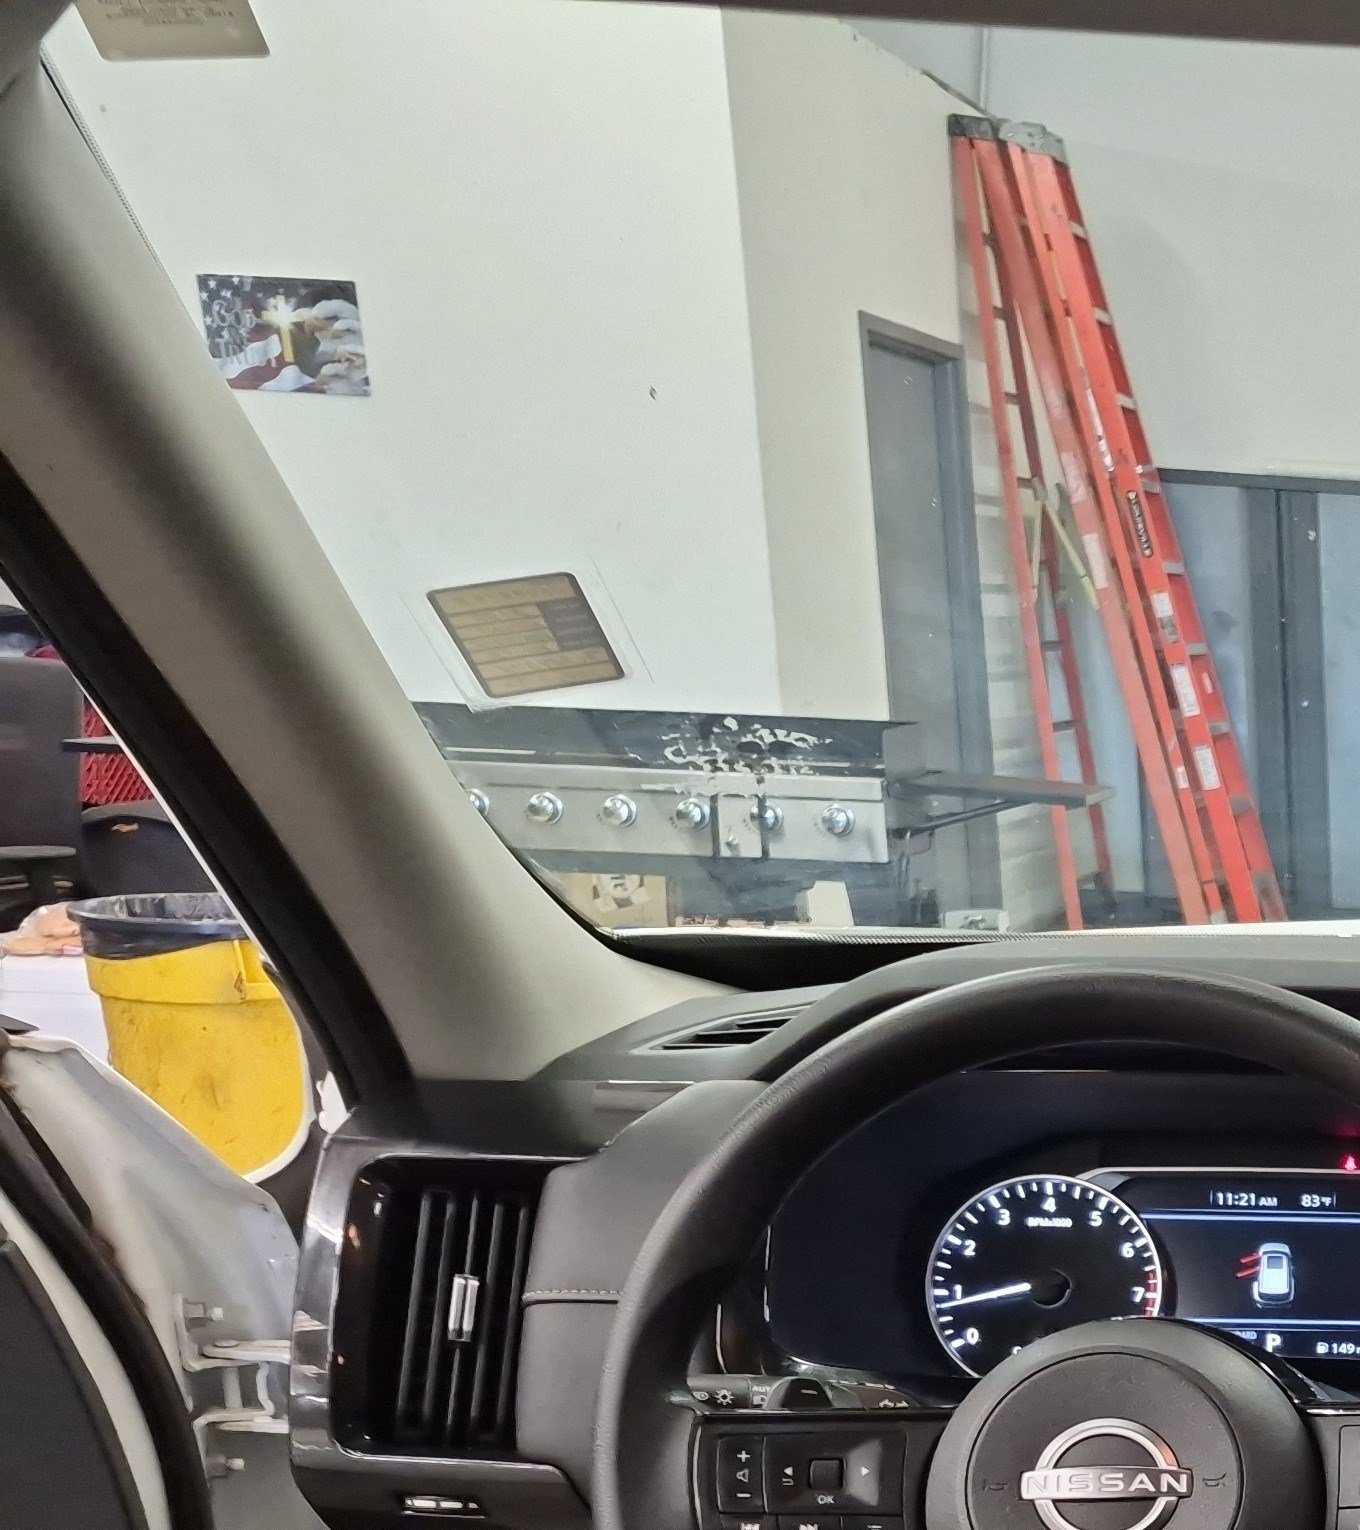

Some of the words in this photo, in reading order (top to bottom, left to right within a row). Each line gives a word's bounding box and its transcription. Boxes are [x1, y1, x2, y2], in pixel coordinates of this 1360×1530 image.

[1043, 1196, 1056, 1212] 4
[1215, 1192, 1256, 1206] 11:21
[1258, 1197, 1278, 1207] AM
[997, 1209, 1011, 1226] 3
[1089, 1210, 1102, 1226] 5
[962, 1240, 976, 1256] 2
[1120, 1242, 1135, 1258] 6
[1131, 1286, 1145, 1303] 7
[966, 1328, 980, 1345] 0
[1266, 1333, 1282, 1352] P
[1331, 1342, 1356, 1355] 149
[752, 1385, 771, 1393] AUT
[1026, 1472, 1188, 1494] NISSAN
[816, 1494, 836, 1505] OK
